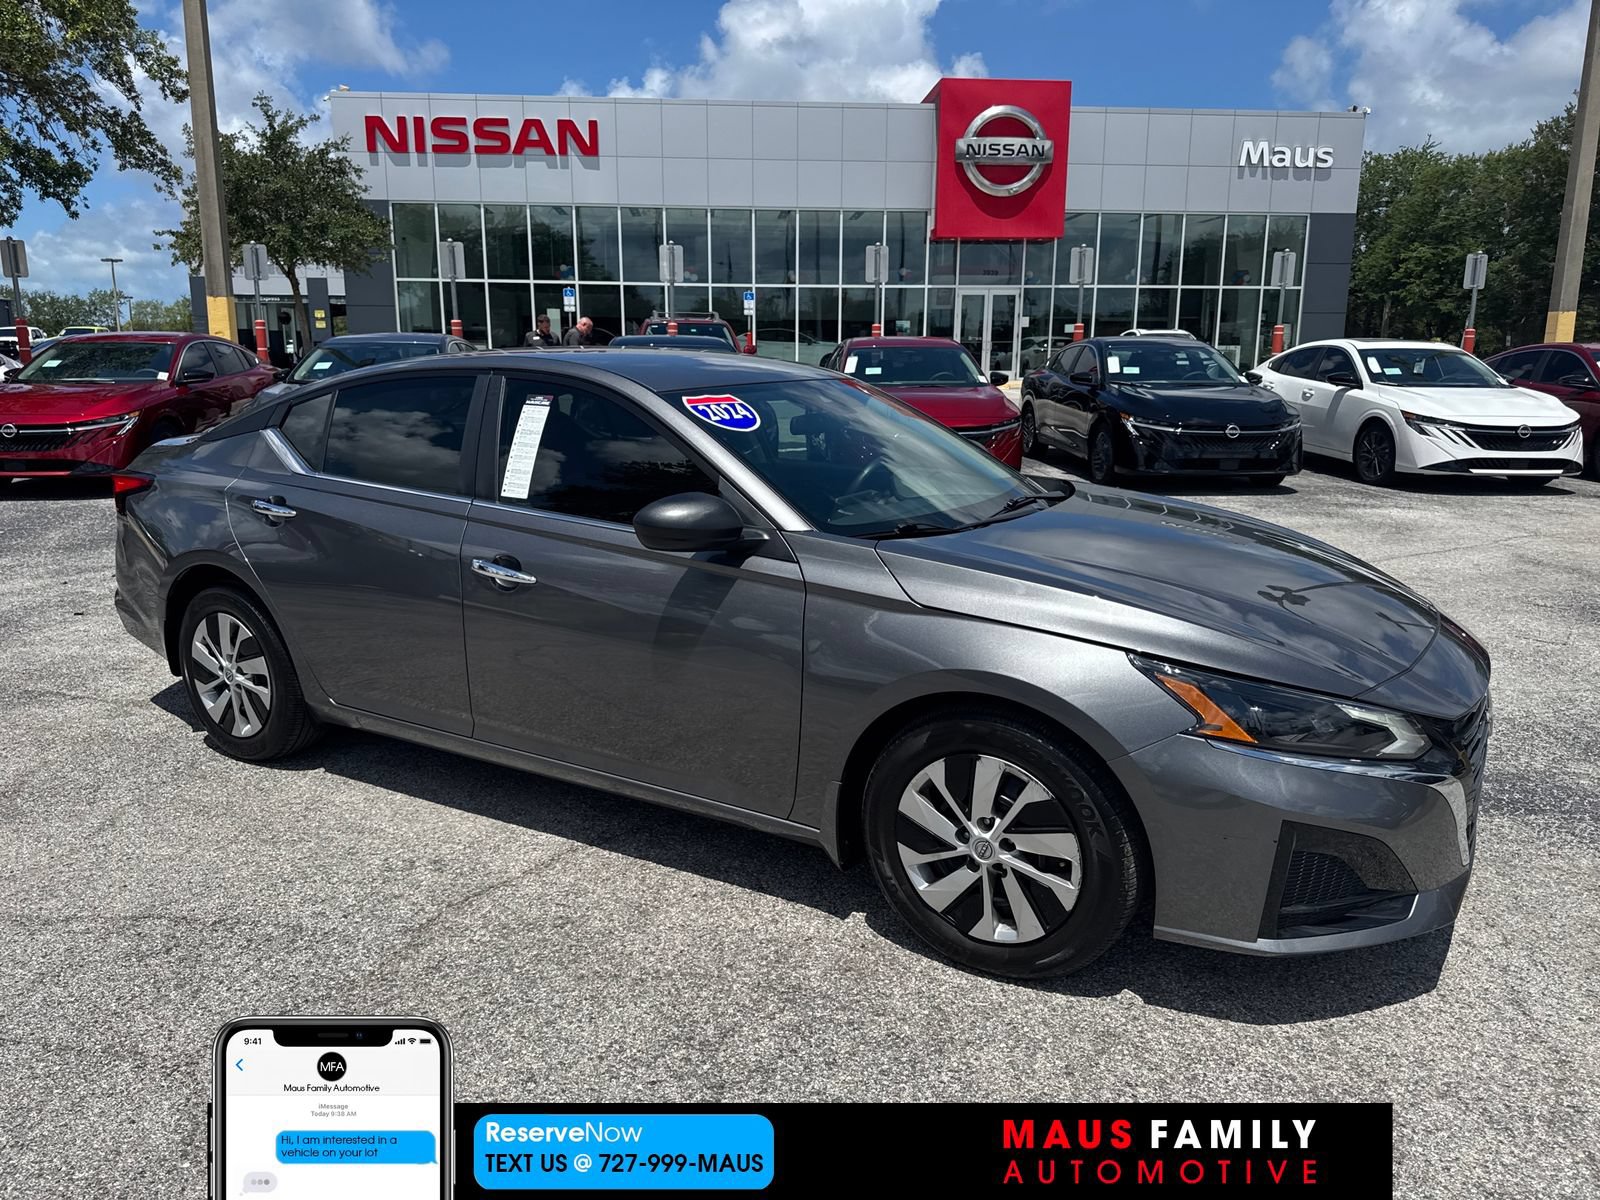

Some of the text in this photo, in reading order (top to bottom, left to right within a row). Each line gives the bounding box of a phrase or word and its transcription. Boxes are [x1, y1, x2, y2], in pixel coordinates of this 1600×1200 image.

[365, 115, 599, 157] NISSAN
[966, 143, 1046, 158] NISSAN
[1238, 140, 1335, 168] Maus
[697, 403, 754, 421] 2024
